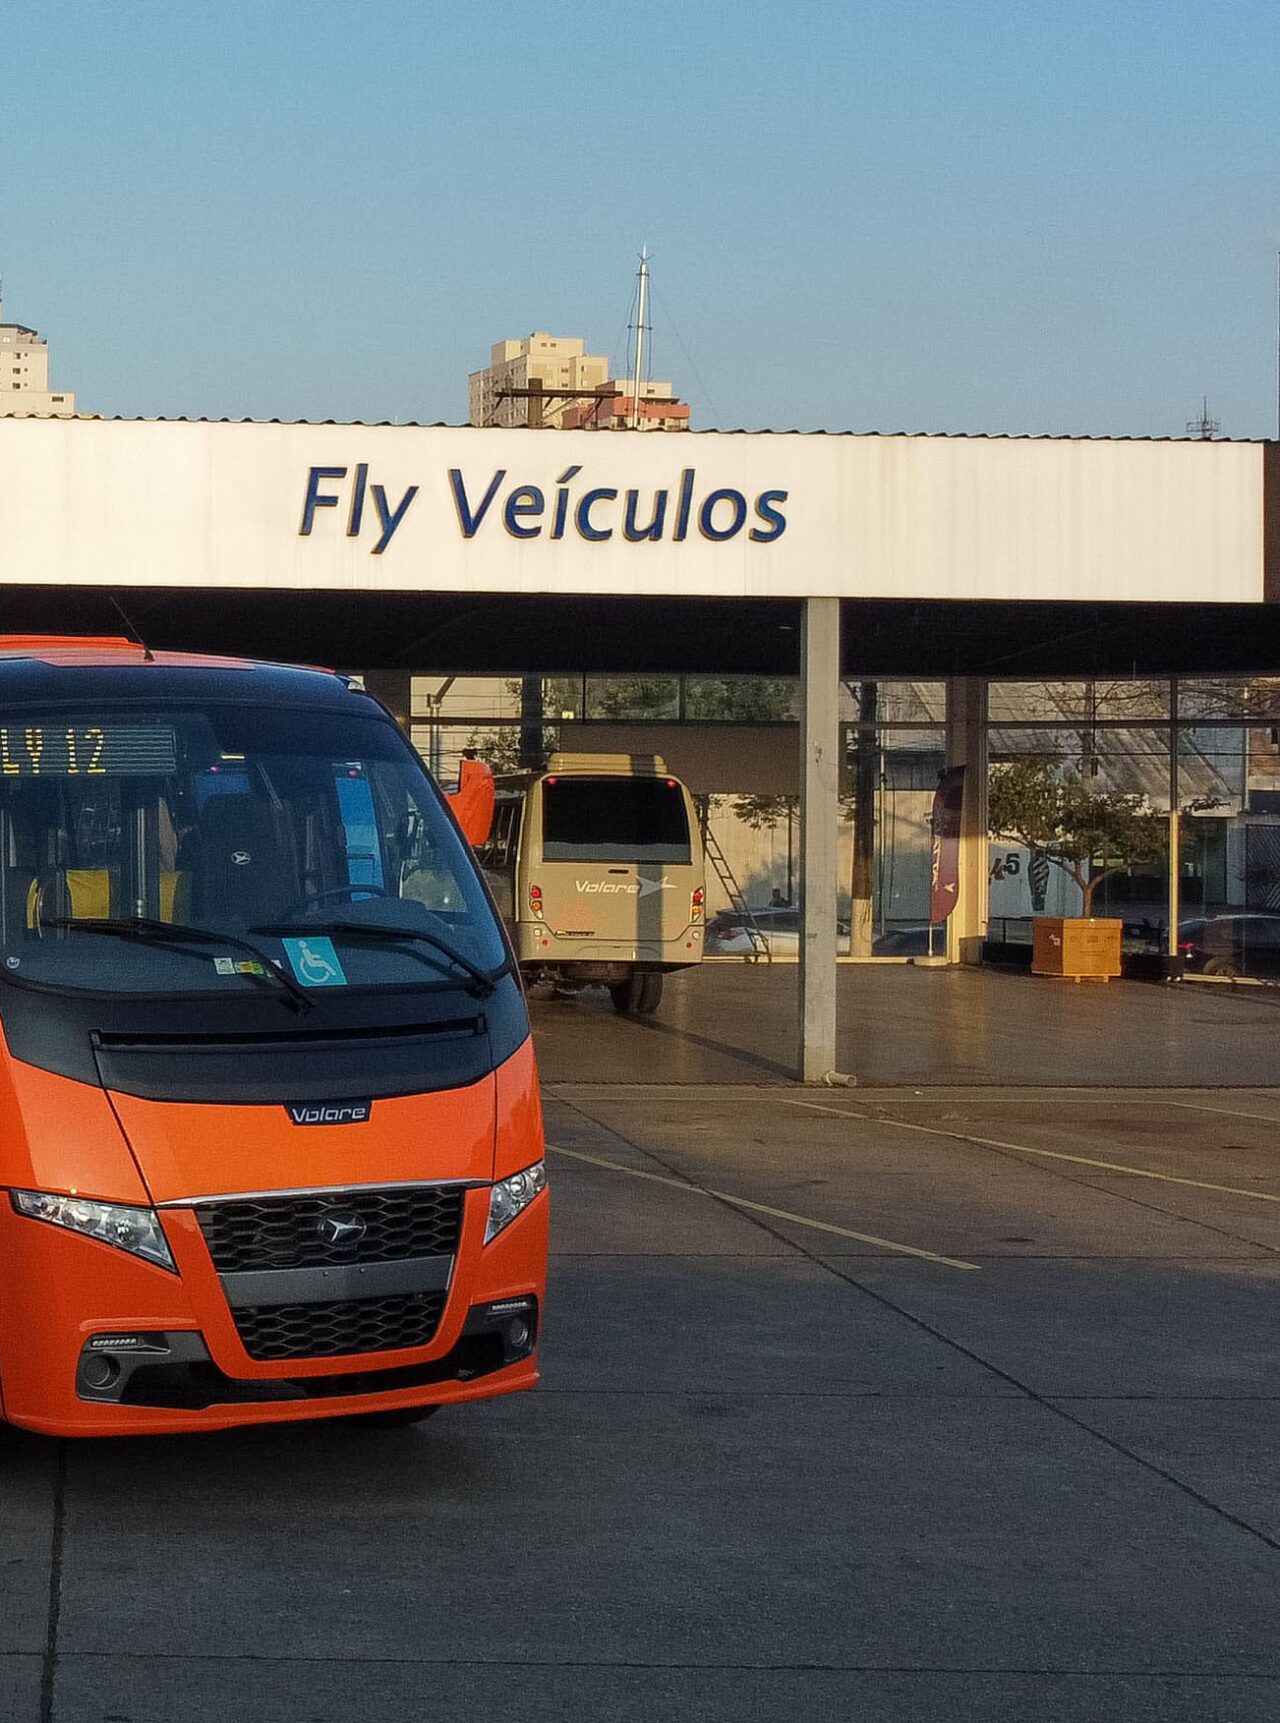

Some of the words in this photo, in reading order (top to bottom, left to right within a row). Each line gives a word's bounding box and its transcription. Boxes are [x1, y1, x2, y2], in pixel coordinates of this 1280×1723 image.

[298, 463, 419, 554] Fly
[447, 465, 789, 543] Veículos
[66, 728, 106, 774] 12
[575, 880, 640, 894] Volare
[292, 1107, 366, 1122] Volare
